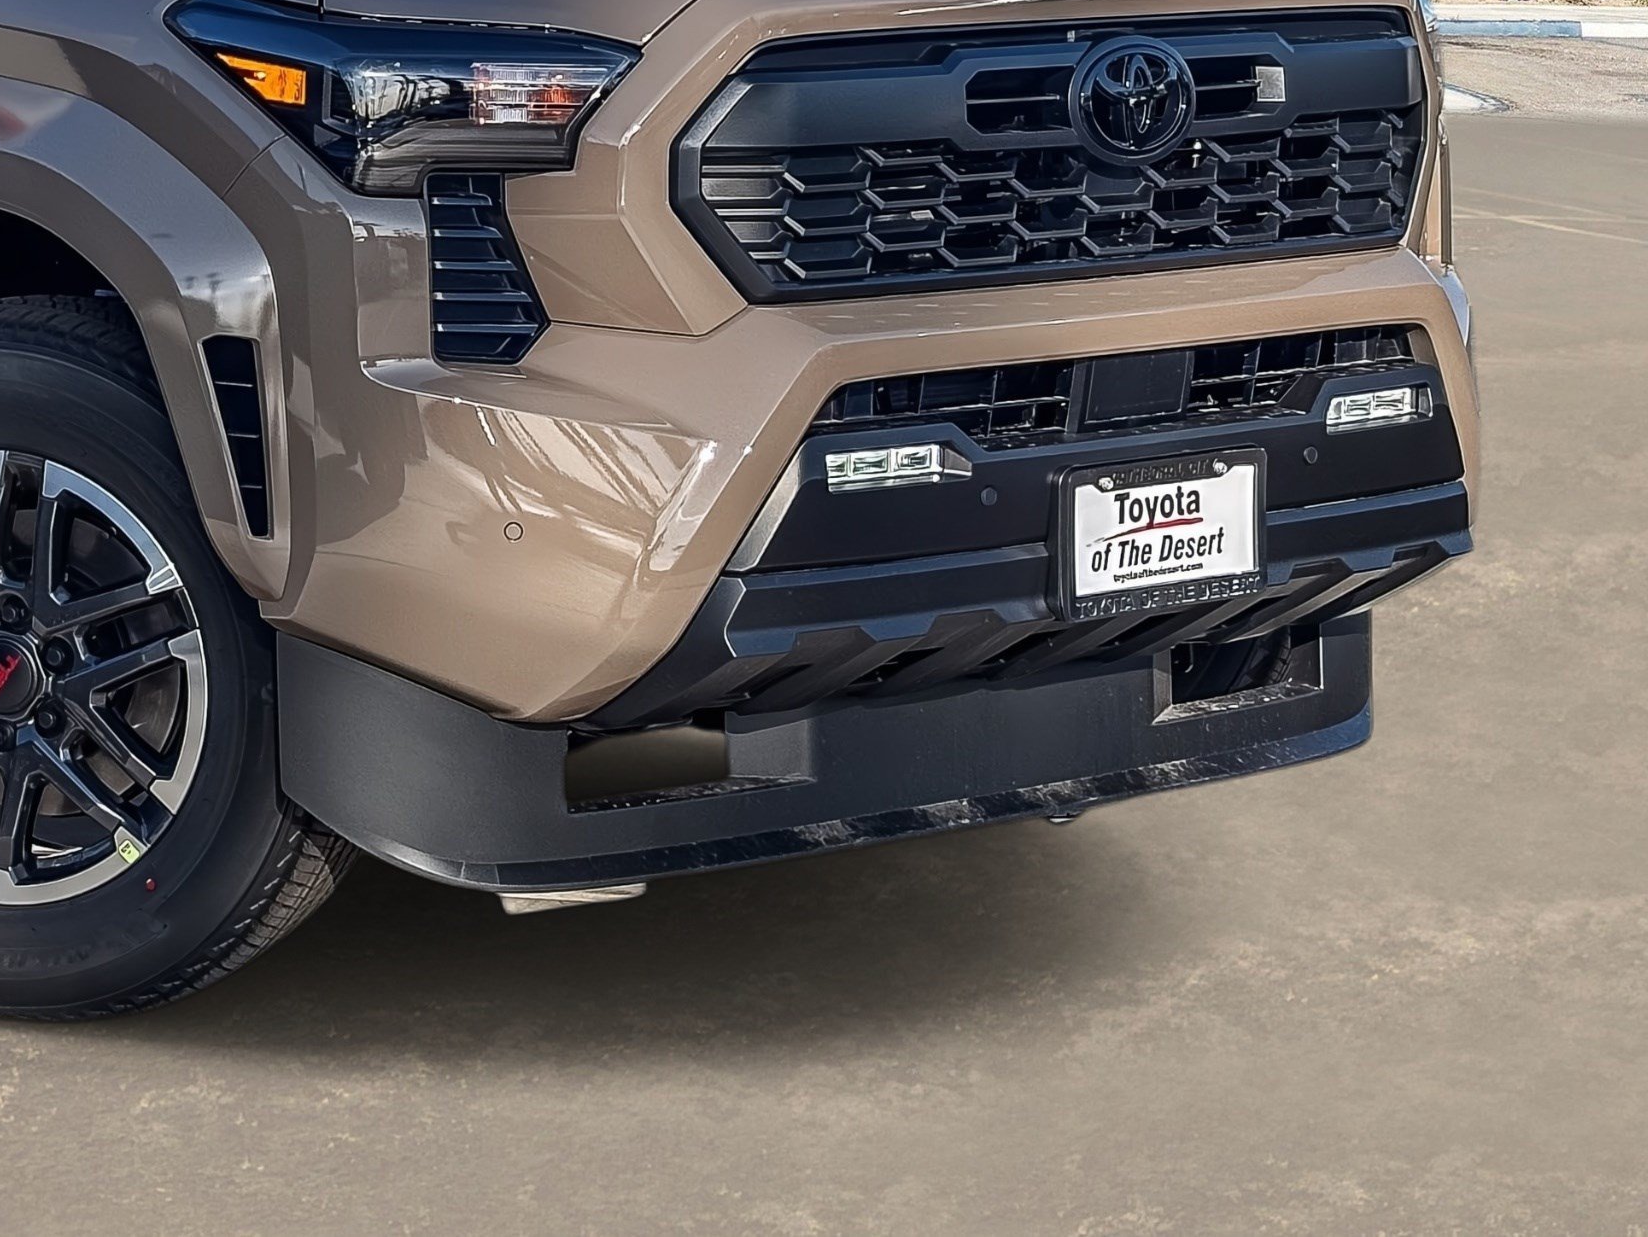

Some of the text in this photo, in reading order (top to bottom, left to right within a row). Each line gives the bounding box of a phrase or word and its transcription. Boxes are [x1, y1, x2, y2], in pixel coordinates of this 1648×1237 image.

[1114, 486, 1200, 528] Toyota
[1091, 526, 1225, 573] of The Desert
